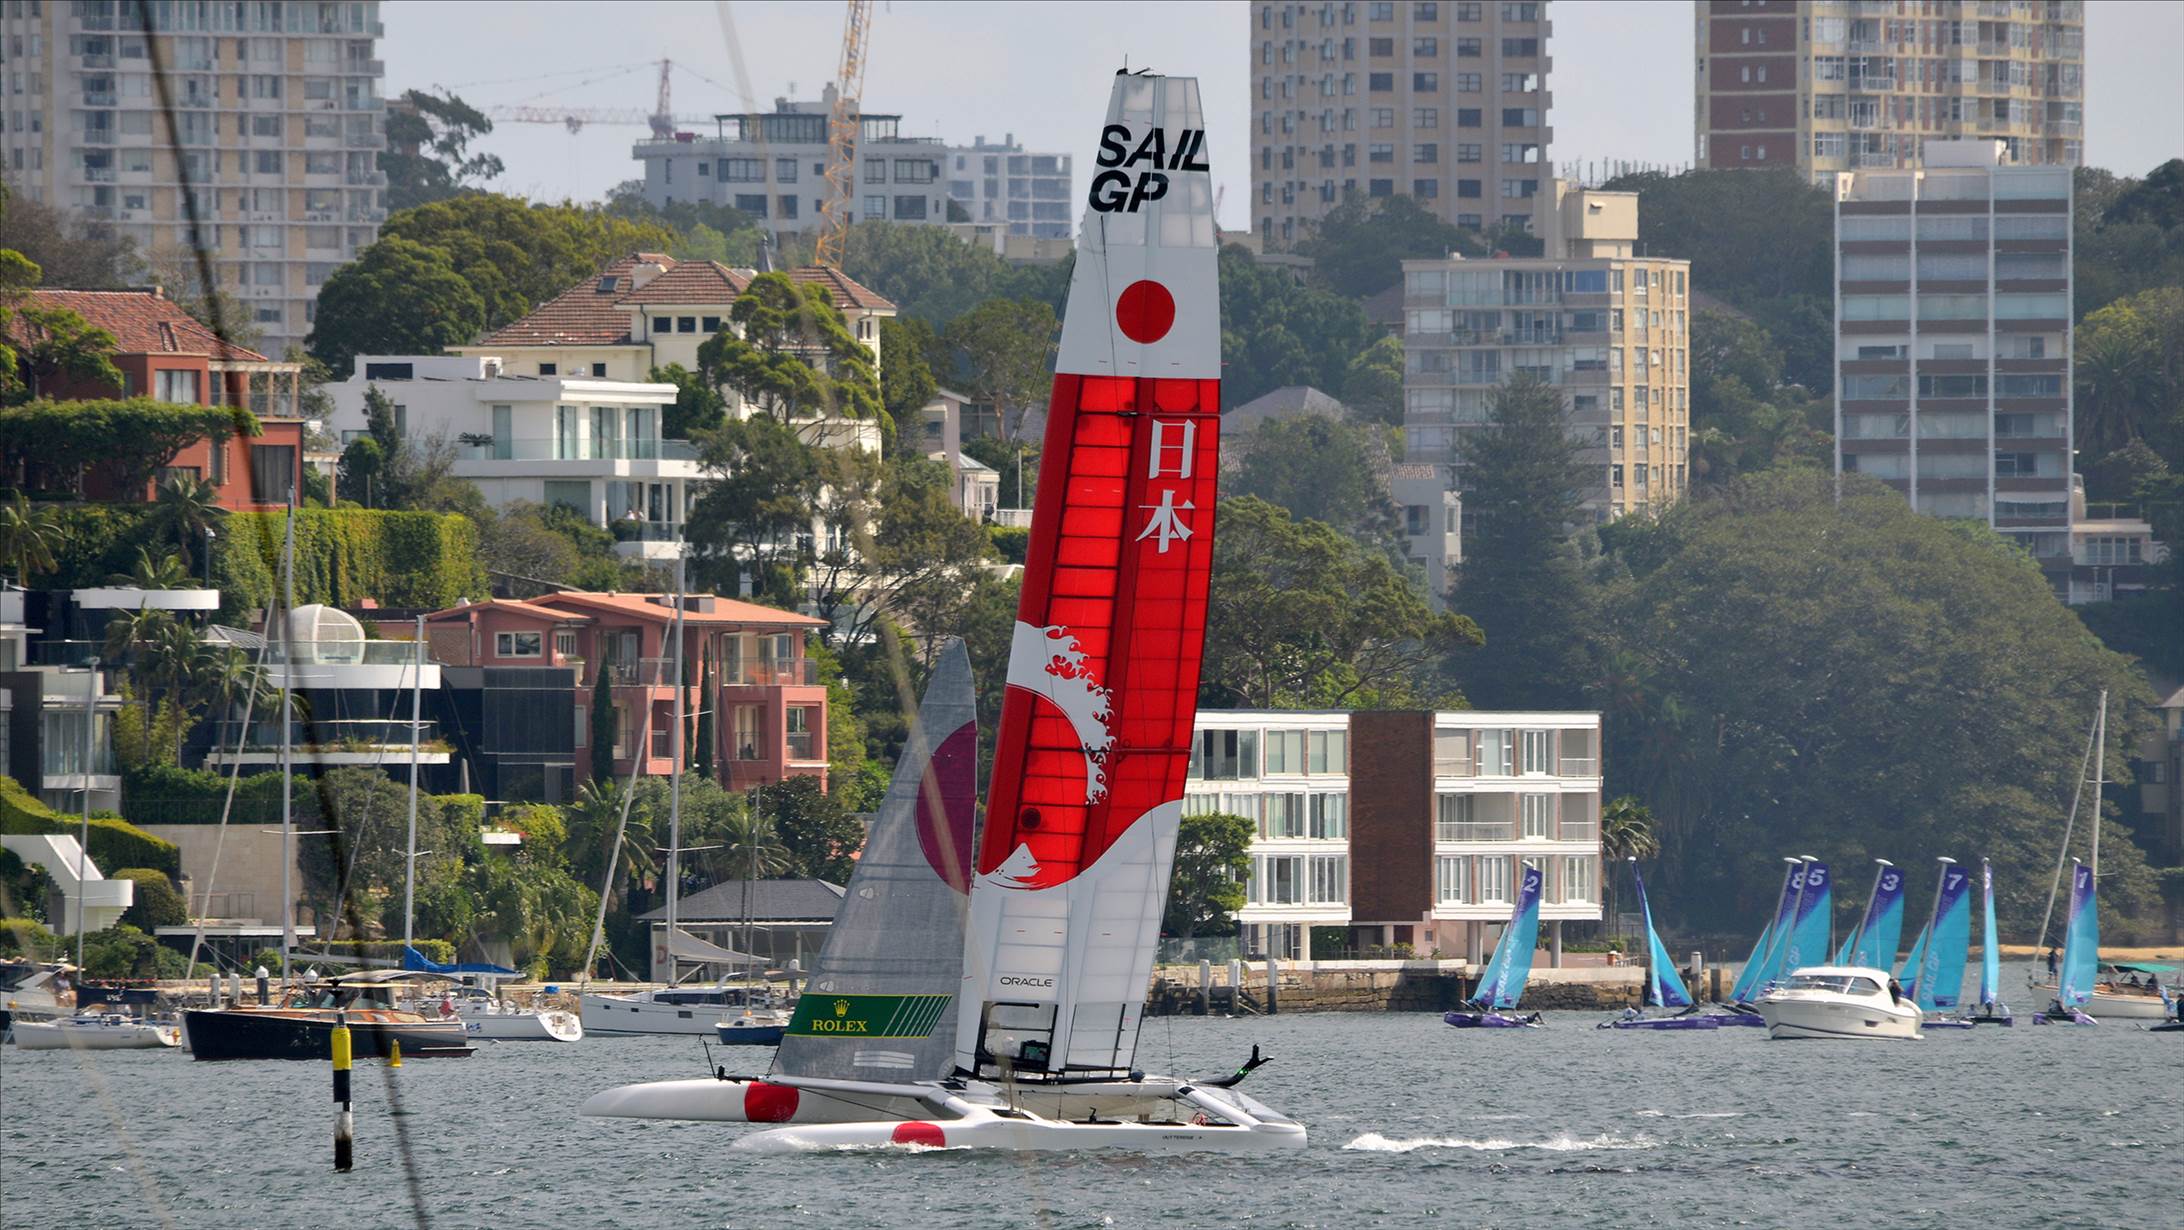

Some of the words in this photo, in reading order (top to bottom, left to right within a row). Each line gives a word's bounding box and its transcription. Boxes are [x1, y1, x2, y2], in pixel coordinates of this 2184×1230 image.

[1096, 124, 1210, 172] SAIL
[1088, 169, 1170, 213] GP
[1135, 418, 1197, 554] 日本
[1523, 875, 1539, 892] 2
[1808, 868, 1826, 886] 5
[1881, 873, 1899, 891] 3
[1947, 873, 1963, 890] 7
[2078, 871, 2088, 889] 1
[1000, 976, 1053, 987] ORACLE
[812, 1019, 868, 1032] ROLEX
